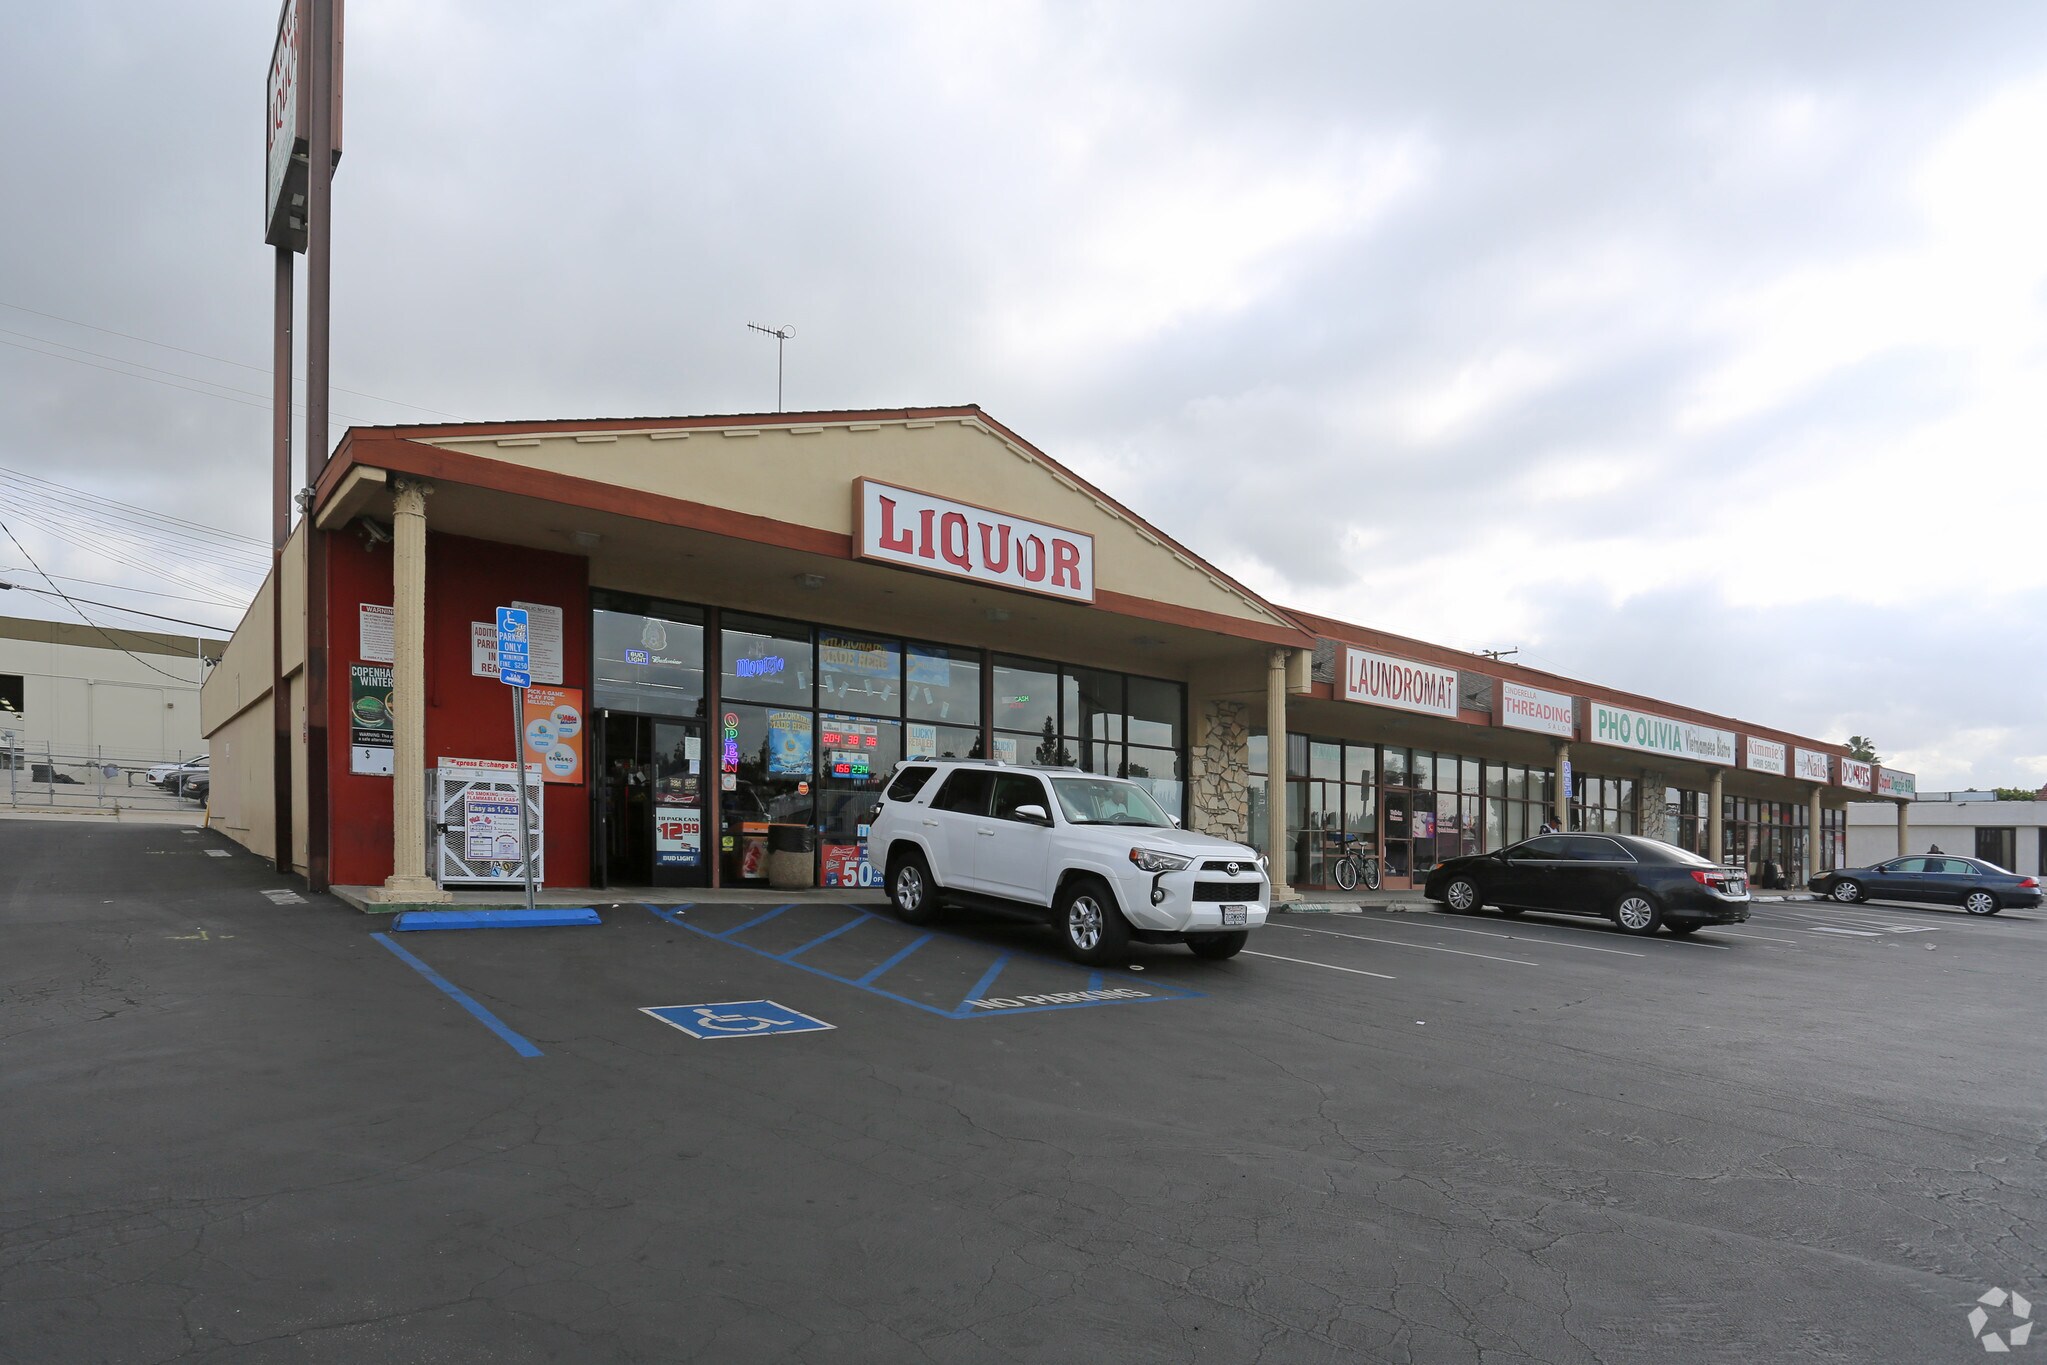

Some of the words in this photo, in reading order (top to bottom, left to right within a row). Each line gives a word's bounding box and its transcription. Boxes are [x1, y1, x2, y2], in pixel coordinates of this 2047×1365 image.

[879, 494, 1081, 590] LIQUOR
[366, 606, 394, 615] WARNIN
[474, 627, 497, 638] ADDITIO
[477, 639, 497, 649] PARKI
[504, 642, 522, 652] ONLY
[488, 652, 496, 661] IN
[823, 650, 855, 666] MADE
[857, 653, 888, 670] HERE
[499, 660, 511, 668] FINE
[514, 661, 528, 669] $250
[352, 666, 394, 678] COPENHA
[360, 676, 394, 688] WINTER
[1349, 655, 1454, 709] LAUNDROMAT
[1504, 685, 1537, 700] CINDERELLA
[1504, 697, 1571, 724] THREADING
[770, 720, 790, 729] MADE
[792, 722, 811, 731] HERE
[1548, 722, 1571, 733] SALON
[1598, 709, 1631, 743] PHO
[1635, 716, 1682, 752] OLIVIA
[823, 731, 840, 743] 204
[848, 734, 859, 745] 38
[865, 737, 877, 747] 36
[912, 727, 934, 739] LUCKY
[724, 712, 739, 773] OPEN
[1748, 740, 1784, 760] Kimmie's
[479, 761, 509, 769] Exchange
[510, 762, 532, 770] Ston
[835, 763, 850, 773] 166
[852, 764, 868, 774] 234
[1753, 758, 1763, 768] HAIR
[1764, 760, 1780, 772] SALON
[1807, 754, 1827, 779] Nails
[1842, 762, 1870, 786] DONUTS
[469, 805, 486, 813] Easy
[842, 861, 872, 887] 50
[965, 995, 1025, 1009] NO
[1018, 988, 1152, 1005] PARKING
